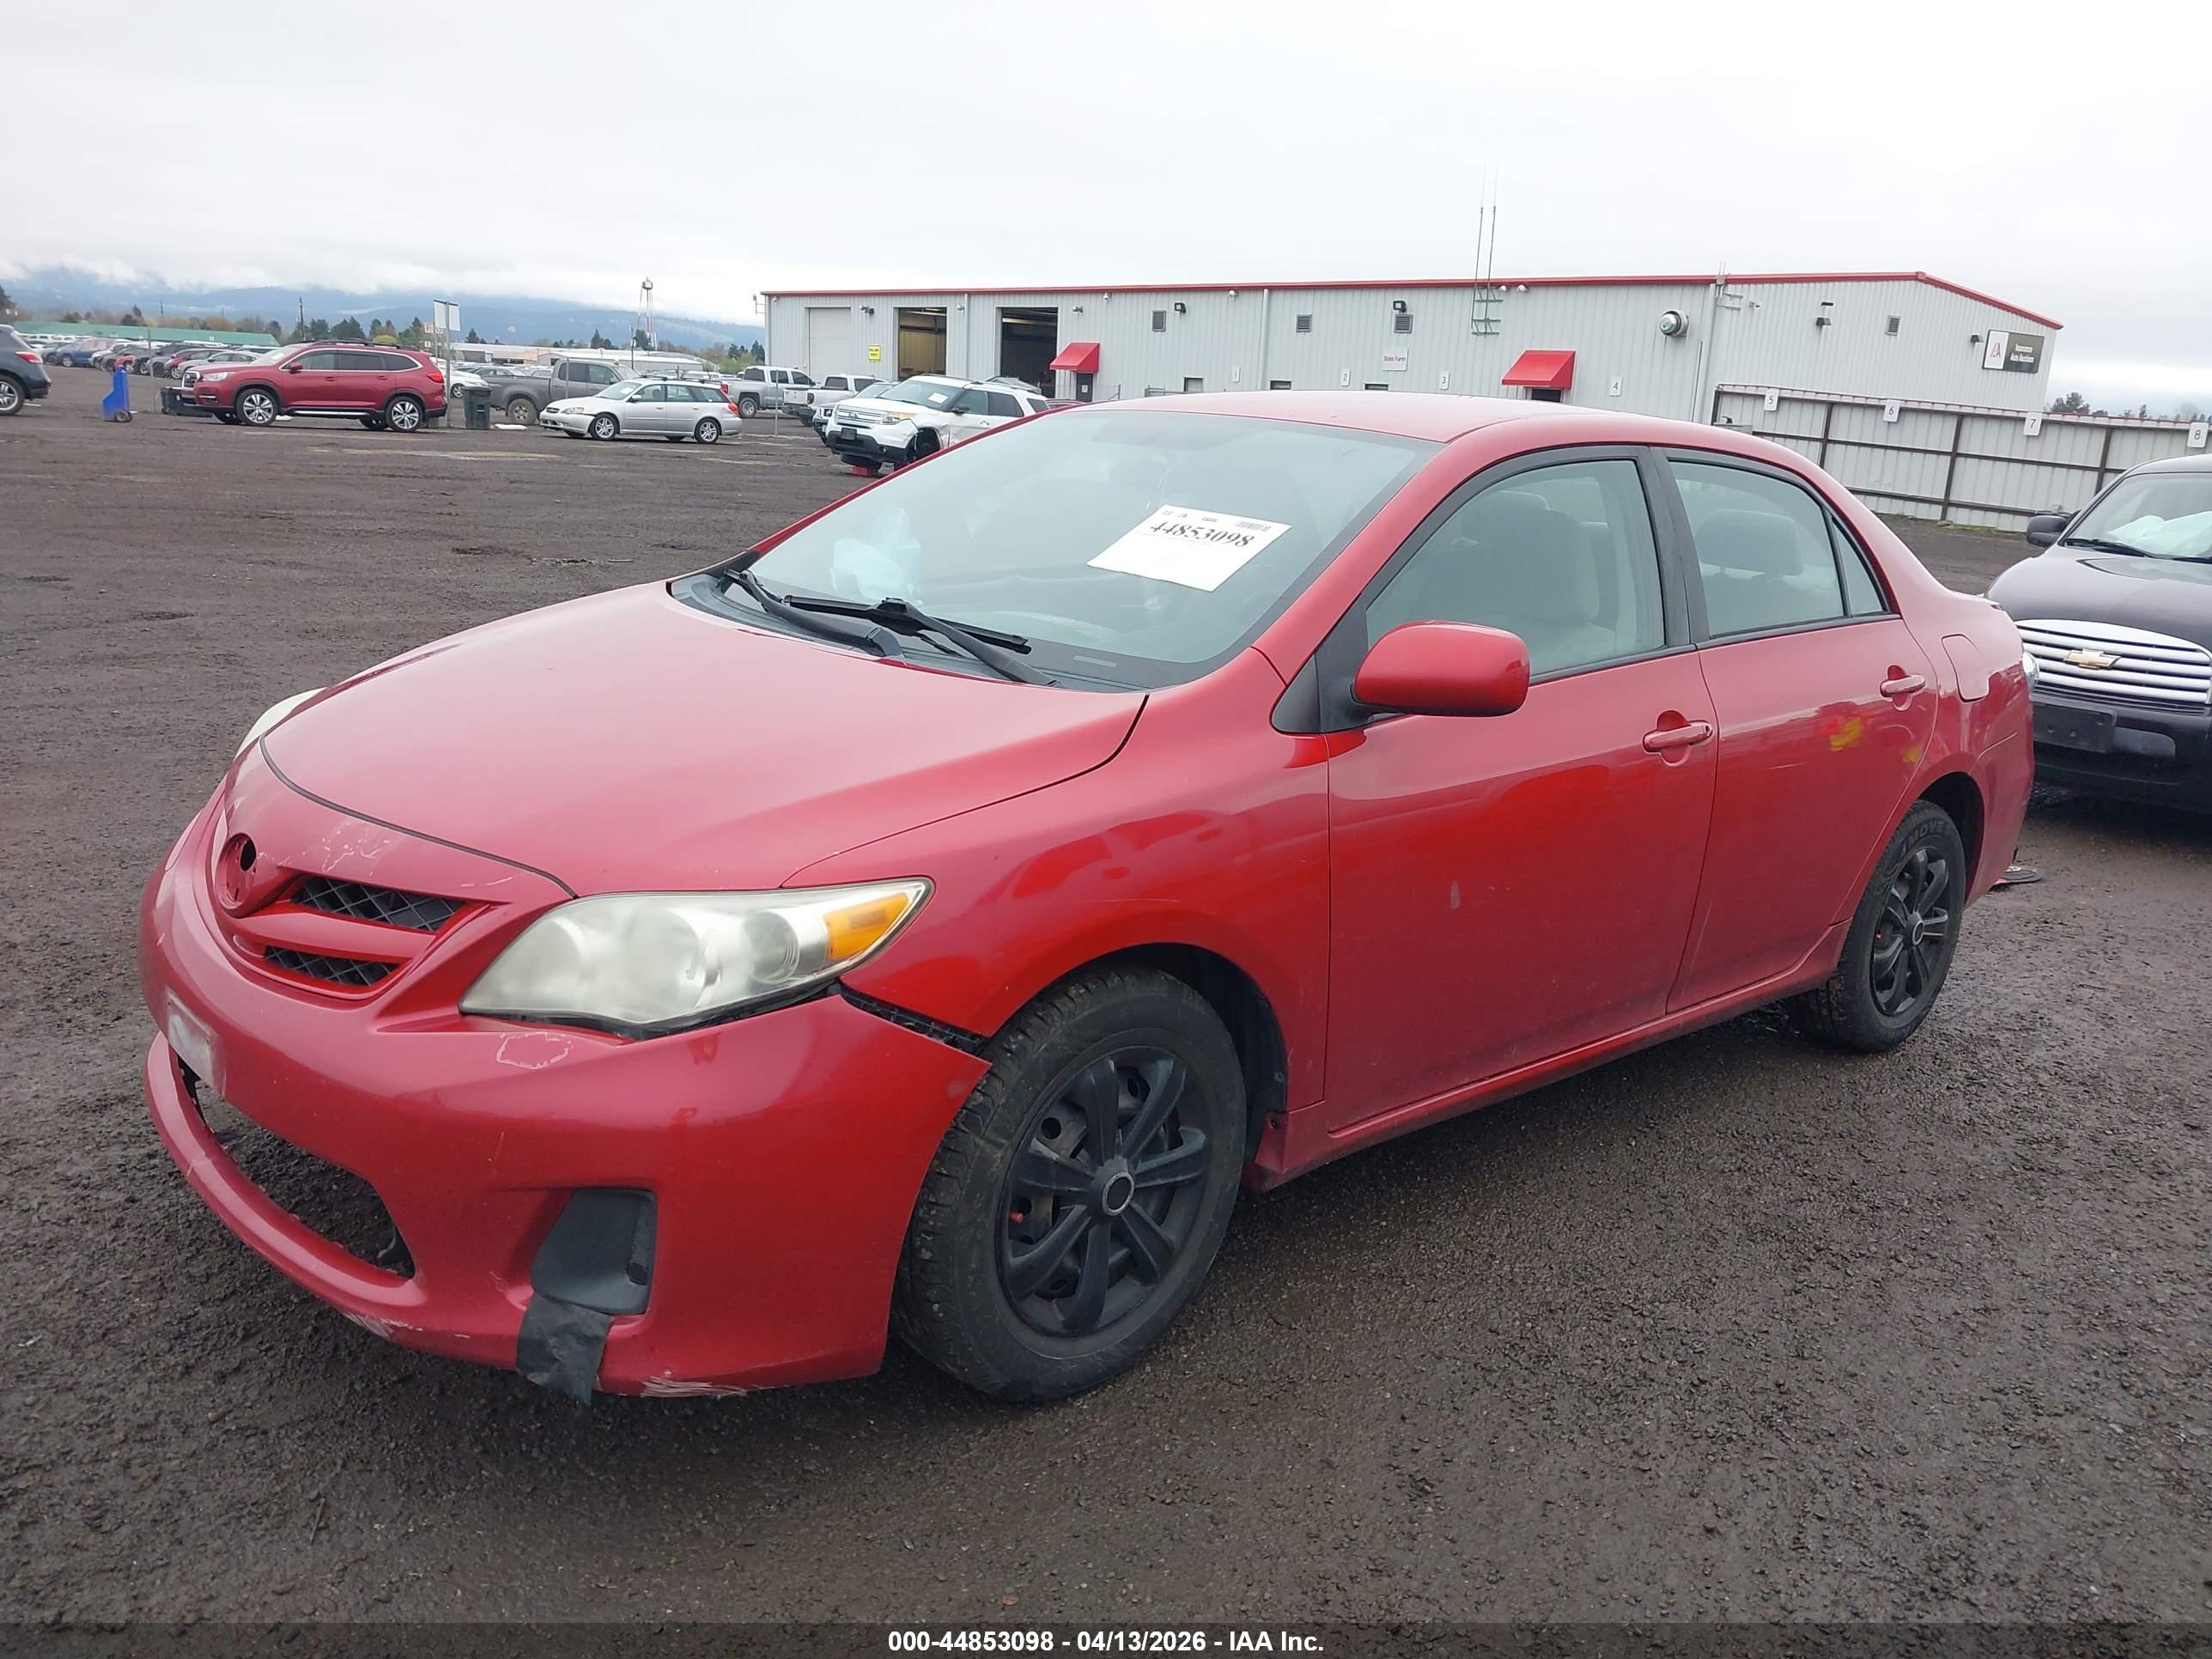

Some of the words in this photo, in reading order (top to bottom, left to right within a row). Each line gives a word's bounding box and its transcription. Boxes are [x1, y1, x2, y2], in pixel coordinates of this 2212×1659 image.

[1343, 373, 1347, 381] 2
[1613, 382, 1619, 391] 4
[1768, 395, 1774, 404] 5
[1888, 406, 1894, 416] 6
[2030, 418, 2037, 428] 7
[2194, 429, 2201, 440] 8
[1150, 521, 1255, 548] 44853098
